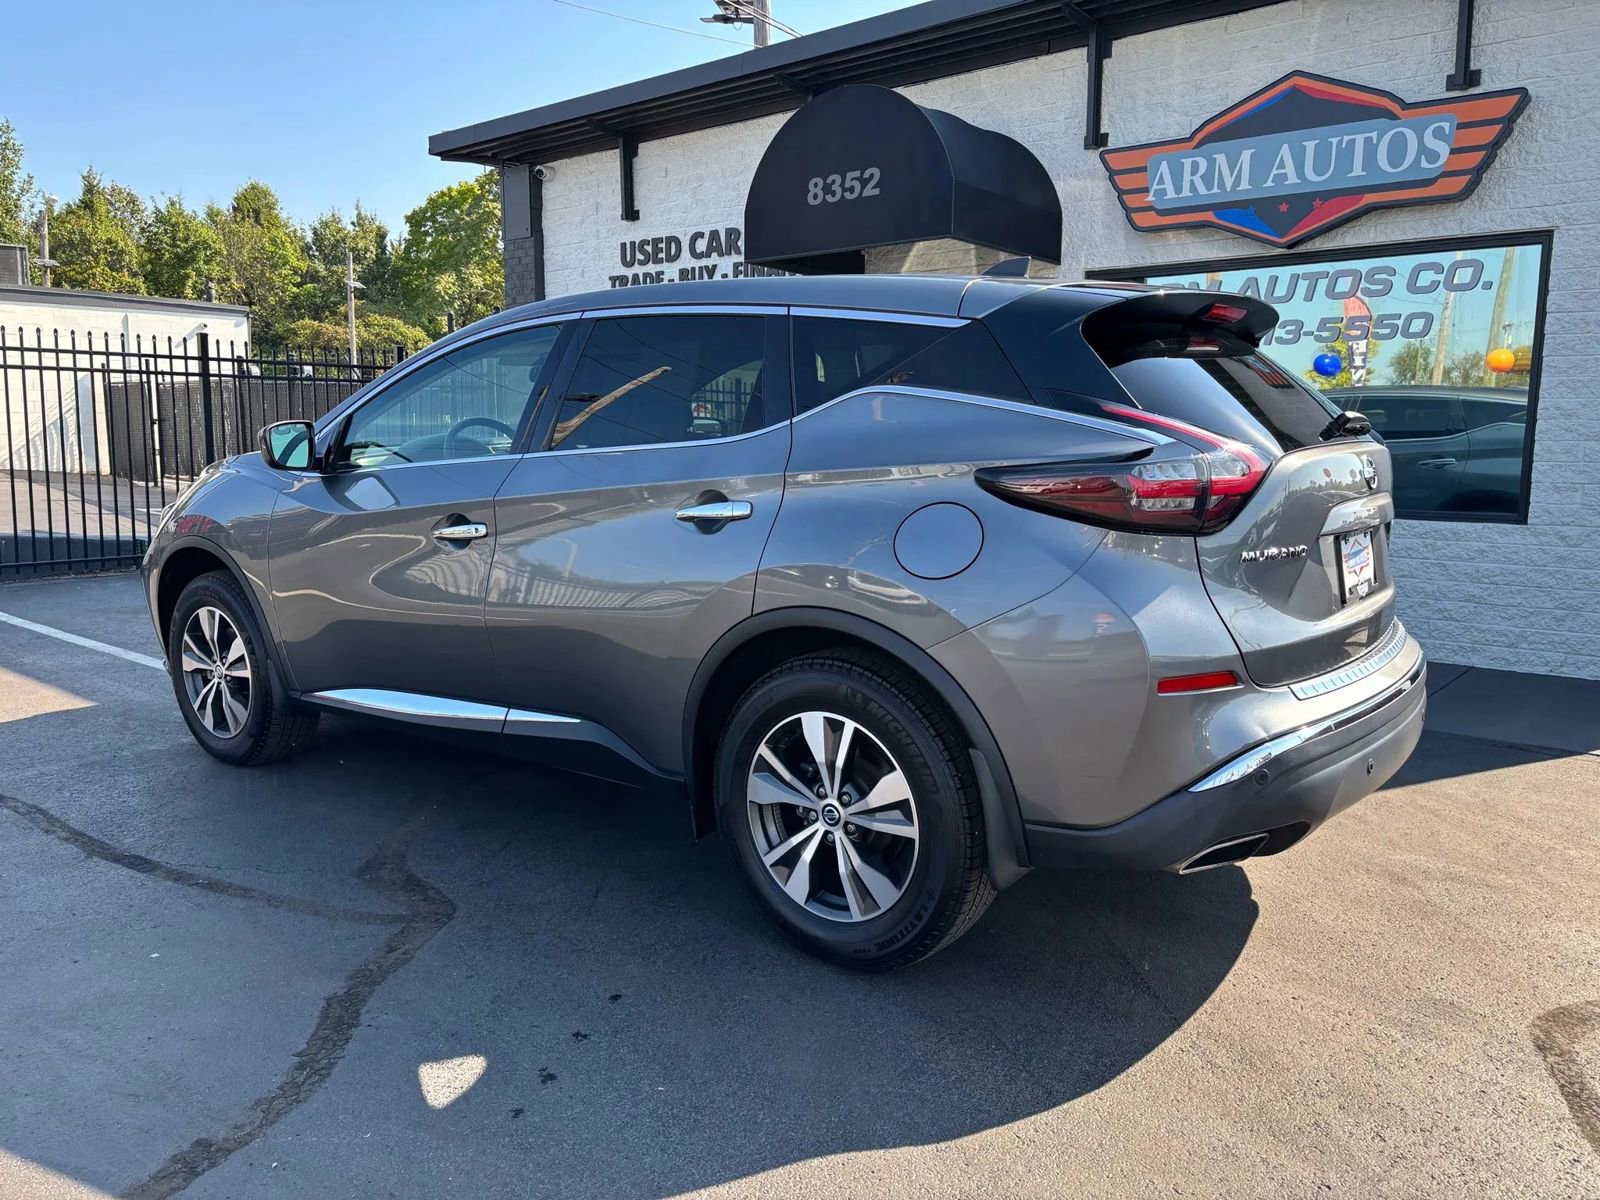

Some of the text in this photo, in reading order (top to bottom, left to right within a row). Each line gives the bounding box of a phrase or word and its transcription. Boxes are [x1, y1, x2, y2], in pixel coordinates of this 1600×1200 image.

[1144, 121, 1453, 202] ARM AUTOS
[806, 166, 881, 206] 8352
[619, 227, 742, 268] USED CAR
[609, 270, 665, 288] TRADE
[678, 264, 718, 282] BUY
[1236, 258, 1494, 304] AUTOS CO.
[1241, 545, 1308, 562] MURANO
